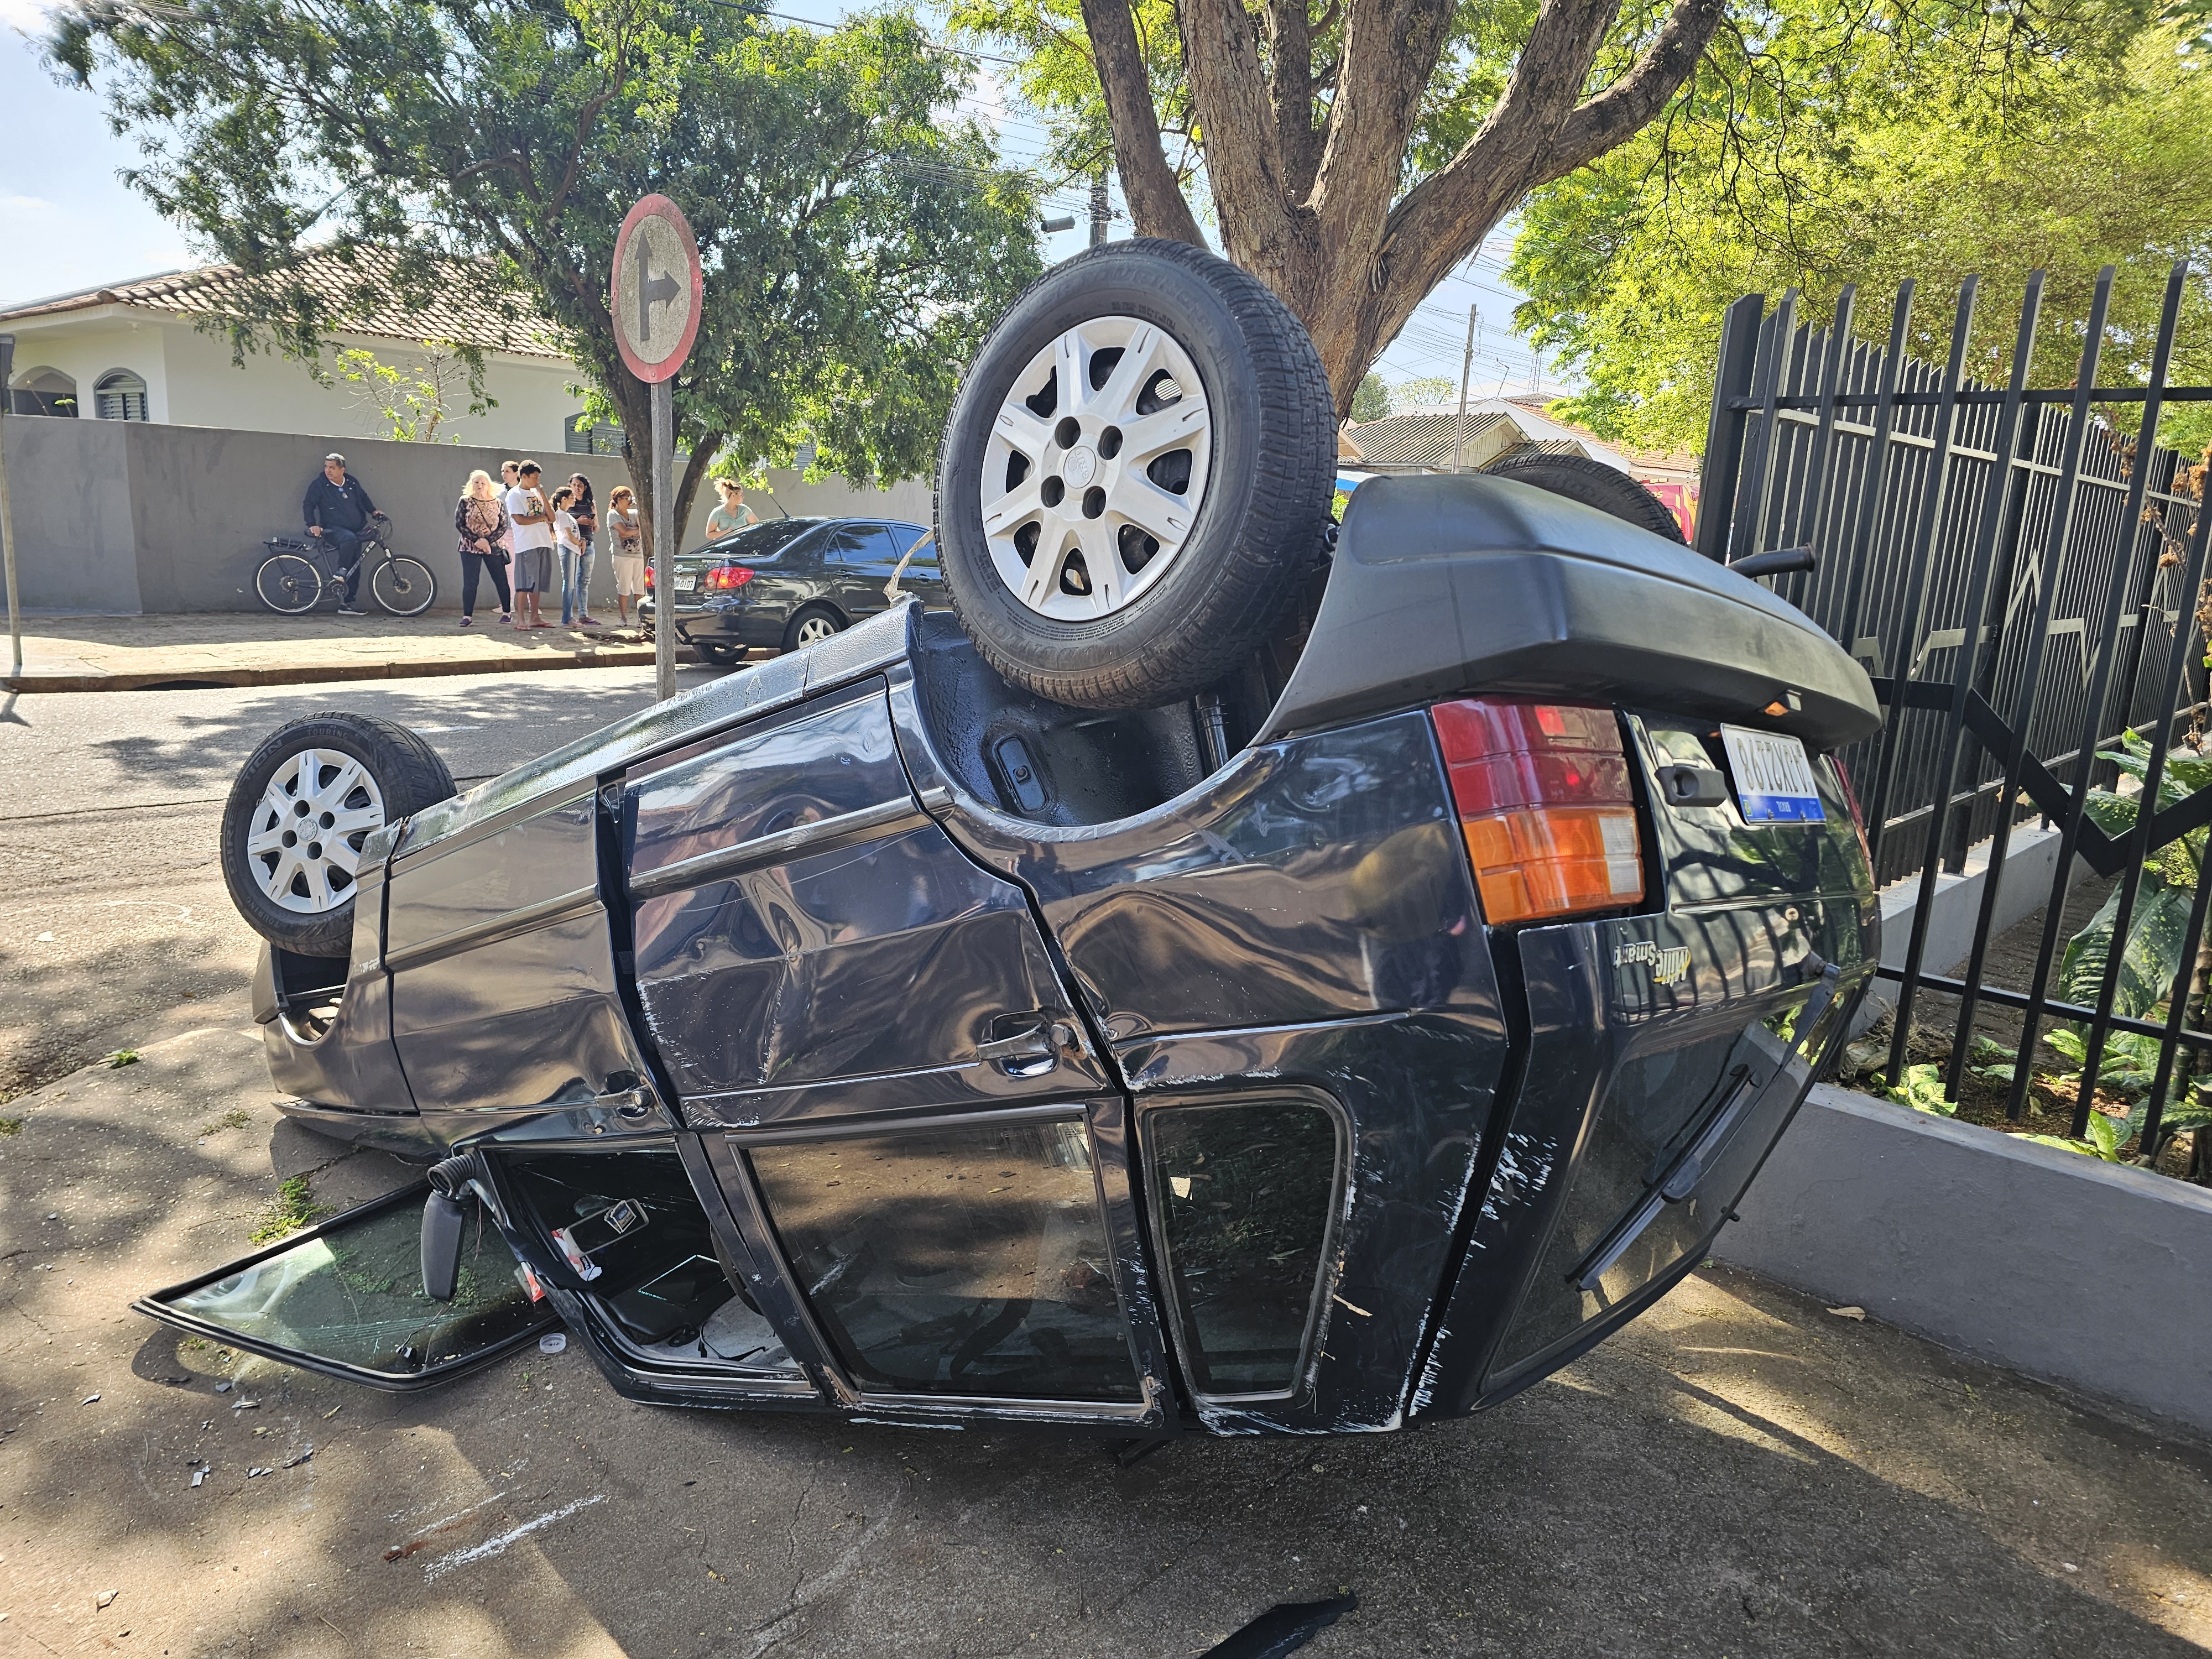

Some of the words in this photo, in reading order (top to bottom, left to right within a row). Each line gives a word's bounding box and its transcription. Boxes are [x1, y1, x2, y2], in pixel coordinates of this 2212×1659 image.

[1075, 448, 1089, 481] GRID
[977, 611, 1079, 666] DUNLOP
[305, 727, 348, 740] TOURING
[1776, 801, 1791, 812] BRASIL
[243, 896, 282, 929] TOURING
[1613, 941, 1657, 969] Smart
[1654, 946, 1688, 988] Mille
